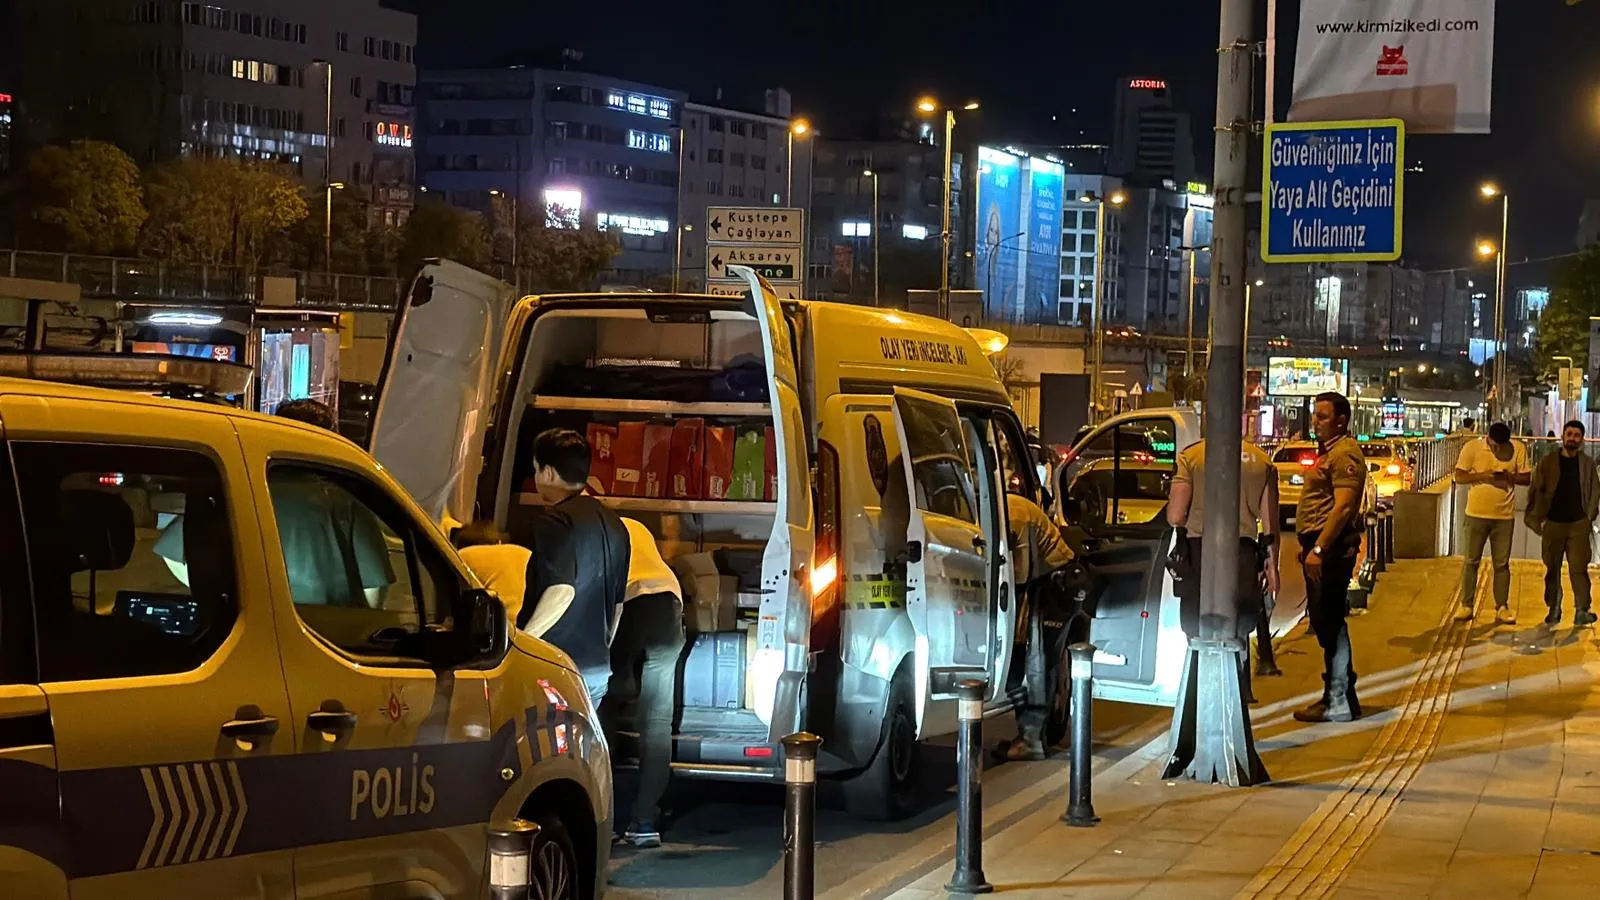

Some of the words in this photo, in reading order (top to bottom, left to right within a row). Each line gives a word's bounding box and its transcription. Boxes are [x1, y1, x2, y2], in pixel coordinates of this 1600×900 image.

[1316, 19, 1479, 34] www.kirmizikedi.com
[1130, 80, 1166, 88] ASTORIA
[376, 122, 412, 139] OWL
[1271, 136, 1362, 173] Güvenliğiniz
[1367, 129, 1394, 171] İçin
[1270, 180, 1303, 216] Yaya
[1306, 181, 1328, 209] Alt
[1332, 178, 1393, 214] Geçidini
[728, 212, 788, 225] Kuştepe
[727, 226, 792, 240] Çağlayan
[1293, 218, 1366, 248] Kullanınız
[729, 250, 791, 263] Aksaray
[880, 336, 900, 360] OLAY
[351, 752, 436, 821] POLİS
